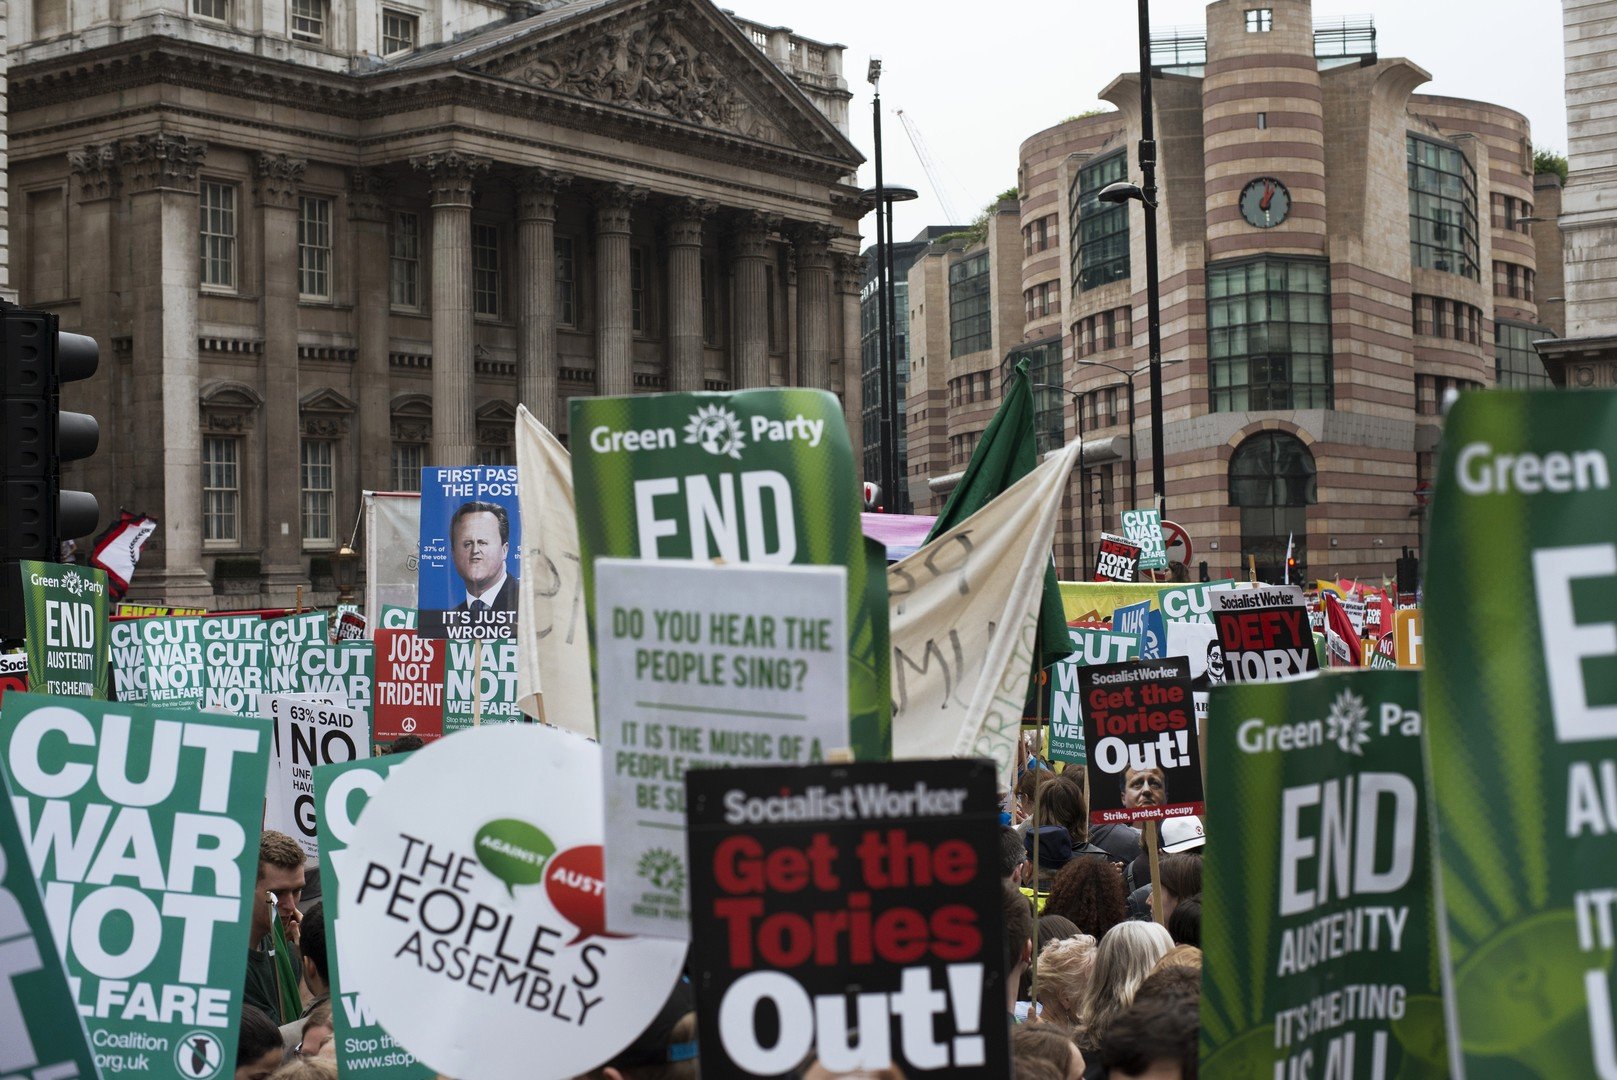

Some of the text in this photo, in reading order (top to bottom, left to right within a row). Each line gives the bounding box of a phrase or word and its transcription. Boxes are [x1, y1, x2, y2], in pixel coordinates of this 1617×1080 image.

[590, 414, 824, 453] Green Party
[437, 469, 518, 482] FIRST PAS
[1457, 444, 1610, 496] Green
[442, 484, 519, 497] THE POST
[634, 470, 797, 565] END
[1124, 511, 1158, 528] CUT
[1125, 525, 1161, 541] WAR
[1101, 552, 1136, 570] TORY
[1102, 541, 1138, 559] DEFY
[31, 573, 103, 597] Green Party
[1097, 563, 1133, 582] RULE
[1163, 584, 1231, 617] CU
[46, 600, 94, 649] END
[202, 618, 258, 640] CUT
[442, 610, 516, 624] IT'S JUST
[613, 607, 833, 652] DO YOU HEAR THE
[1121, 608, 1144, 634] NHS
[112, 622, 143, 648] CU
[144, 619, 200, 646] CUT
[270, 615, 325, 646] CUT
[446, 626, 511, 639] WRONG
[1220, 611, 1302, 650] DEFY
[1534, 543, 1617, 742] E
[113, 646, 145, 669] WA
[146, 643, 203, 668] WAR
[207, 642, 263, 667] CUT
[271, 643, 299, 667] WA
[388, 632, 434, 663] JOBS
[450, 644, 518, 671] WAR
[1063, 630, 1137, 665] CUT
[1380, 639, 1393, 655] NO
[0, 657, 27, 671] Soci
[47, 651, 93, 670] AUSTERITY
[302, 648, 373, 676] CUT
[392, 663, 430, 680] NOT
[635, 648, 809, 692] PEOPLE SING?
[1225, 648, 1309, 684] TORY
[1371, 655, 1396, 669] AUST
[47, 680, 93, 696] IT'S CHEATING
[114, 666, 148, 692] NO
[148, 664, 204, 690] NOT
[207, 665, 263, 689] WAR
[302, 676, 372, 701] WAR
[447, 670, 518, 702] NOT
[117, 690, 148, 702] WELF
[151, 688, 204, 701] WELFARE
[206, 688, 260, 713] NOT
[378, 682, 443, 707] TRIDENT
[1089, 686, 1135, 710] Get
[1141, 683, 1184, 706] the
[291, 706, 354, 728] 63% SAID
[447, 701, 521, 716] WELFARE
[1091, 707, 1188, 737] Tories
[290, 723, 357, 768] NO
[621, 721, 825, 761] IT IS THE MUSIC OF A
[1052, 740, 1064, 749] Stop
[1236, 717, 1324, 755] Green
[8, 705, 260, 813] CUT
[1052, 749, 1086, 758] www.stopwa
[1094, 729, 1191, 774] Out!
[292, 767, 313, 780] UNF
[615, 751, 686, 781] PEOPLE
[635, 784, 658, 811] BE
[1565, 760, 1617, 836] AU
[1103, 805, 1194, 821] Strike, protest, occupy
[11, 795, 246, 898] WAR
[1279, 771, 1417, 918] END
[399, 833, 478, 894] THE
[480, 835, 605, 896] AGAINST AUST
[713, 828, 978, 894] Get the
[714, 892, 983, 968] Tories
[1572, 889, 1617, 951] IT
[1277, 906, 1409, 978] AUSTERITY
[394, 931, 604, 1027] ASSEMBLY
[69, 975, 231, 1028] LFARE
[719, 962, 986, 1077] Out!
[93, 1029, 169, 1051] Coalition
[344, 1036, 377, 1053] Stop
[346, 1050, 420, 1071] www.stop
